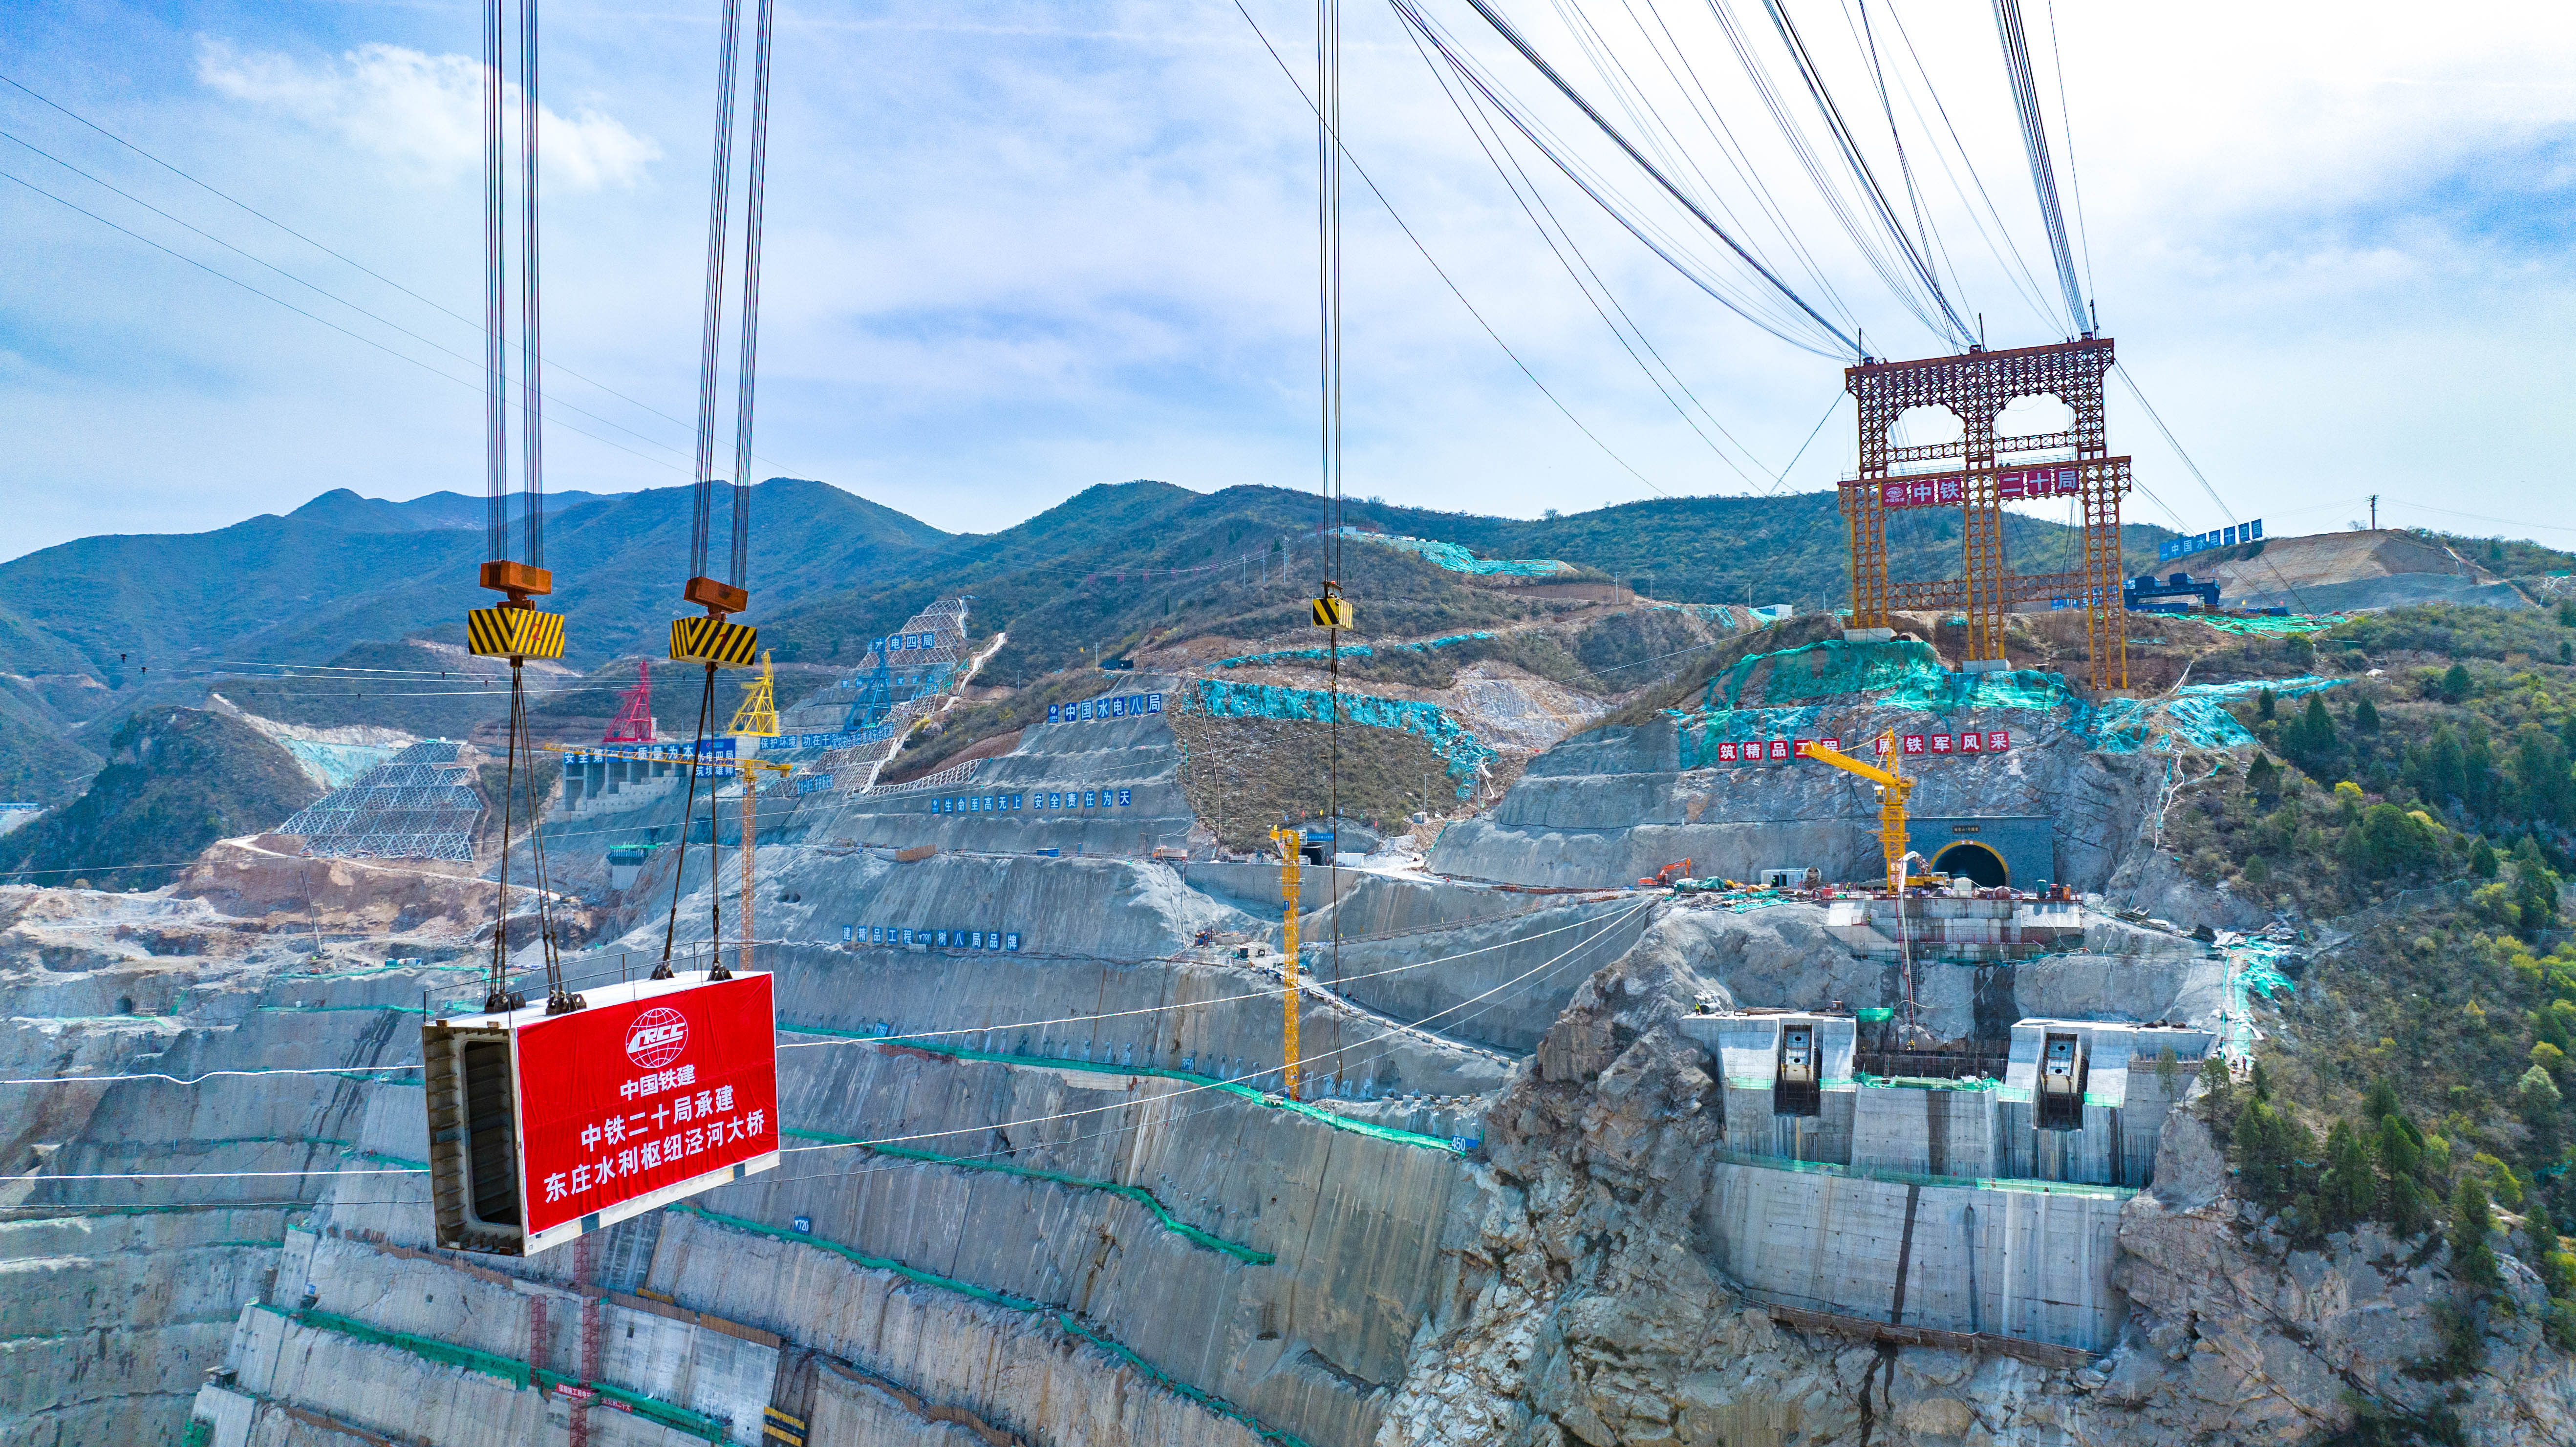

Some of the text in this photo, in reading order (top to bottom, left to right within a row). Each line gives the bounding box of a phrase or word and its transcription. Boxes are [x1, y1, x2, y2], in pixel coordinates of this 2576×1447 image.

[2171, 522, 2260, 555] 中国水电十四局
[532, 623, 540, 640] 2
[719, 633, 727, 648] 1
[1066, 695, 1160, 721] 中国水电八局
[761, 736, 796, 749] 保护环境
[1720, 740, 1838, 760] 筑精品工程
[564, 744, 693, 764] 安全第一 质量为本
[695, 766, 733, 776] 筑坝雄师
[945, 790, 1130, 813] 生命至高无上 安全责任为天
[1285, 901, 1288, 910] 1
[843, 927, 912, 944] 建精品工程
[938, 931, 1018, 950] 树八局品牌
[628, 1022, 686, 1053] CRCC
[620, 1064, 696, 1101] 中国铁建
[581, 1085, 734, 1152] 中铁二十局承建
[1452, 1136, 1465, 1151] 450
[544, 1109, 765, 1204] 东庄水利枢纽泾河大桥
[799, 1219, 809, 1232] 720
